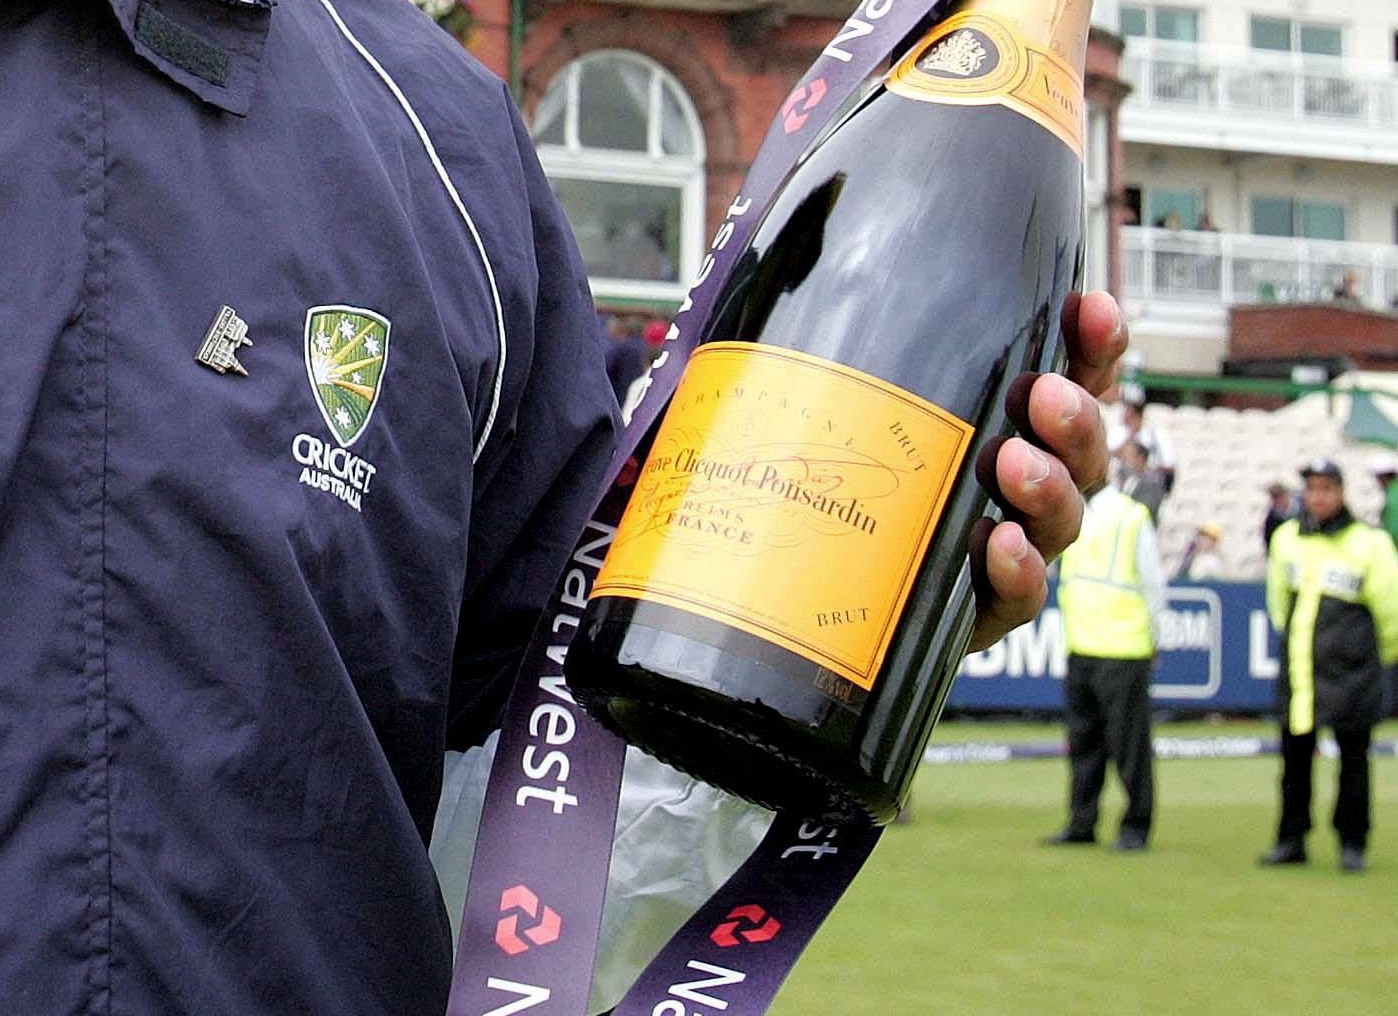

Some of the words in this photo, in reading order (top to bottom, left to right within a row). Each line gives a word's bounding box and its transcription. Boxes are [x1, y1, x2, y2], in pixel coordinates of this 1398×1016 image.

[292, 433, 377, 493] CRICKET
[889, 421, 927, 472] BRUT
[674, 446, 753, 486] Clicquot
[758, 463, 878, 536] Ponsardin
[683, 498, 746, 525] REIMS
[665, 512, 754, 546] FRANCE
[817, 607, 869, 627] BRUT
